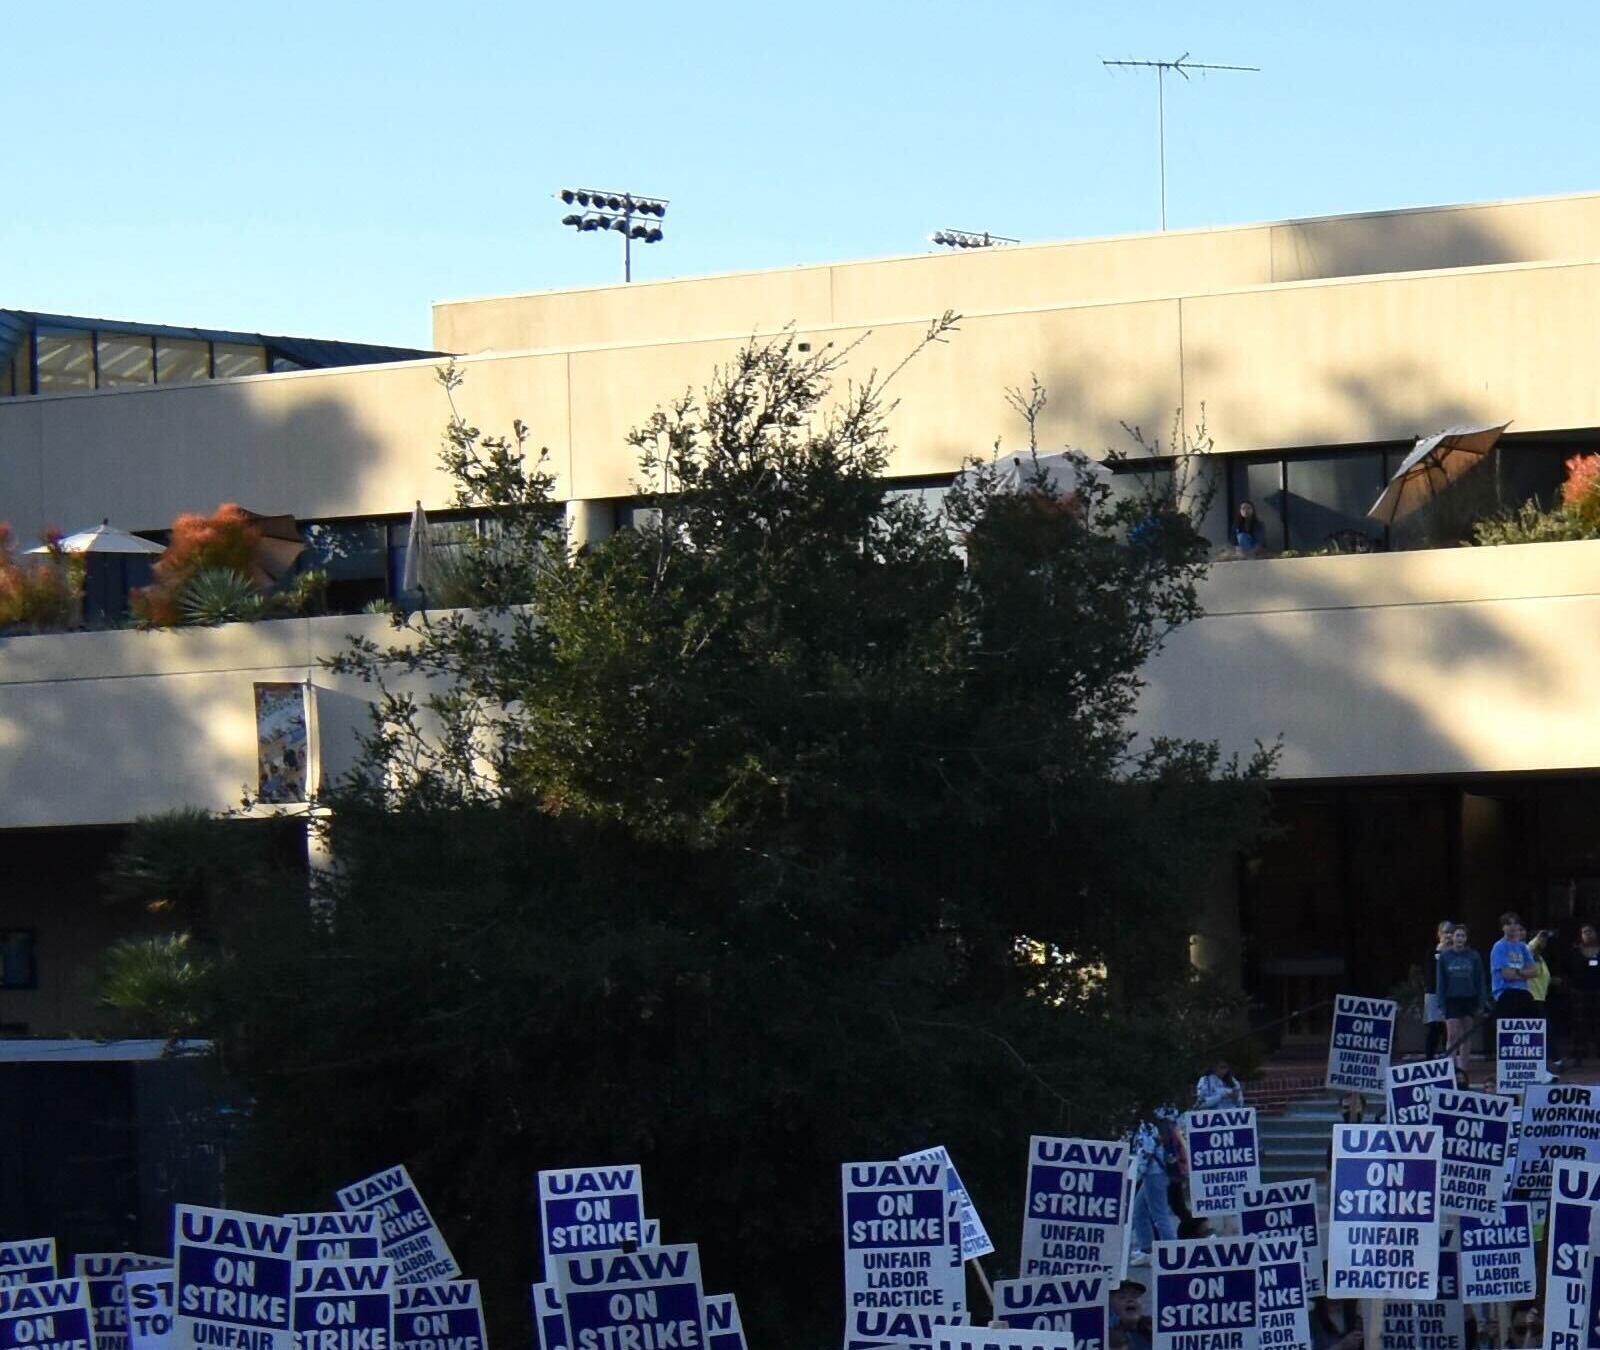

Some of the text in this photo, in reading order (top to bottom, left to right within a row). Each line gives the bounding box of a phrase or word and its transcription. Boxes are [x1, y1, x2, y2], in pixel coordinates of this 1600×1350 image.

[1547, 1088, 1592, 1106] OUR
[1341, 1129, 1436, 1153] UAW
[1538, 1145, 1587, 1160] YOUR
[1365, 1161, 1405, 1187] ON
[1338, 1189, 1432, 1215] STRIKE
[1347, 1226, 1418, 1245] UNFAIR
[1350, 1247, 1414, 1267] LABOR
[1335, 1269, 1429, 1289] PRACTICE
[134, 1314, 173, 1337] TO
